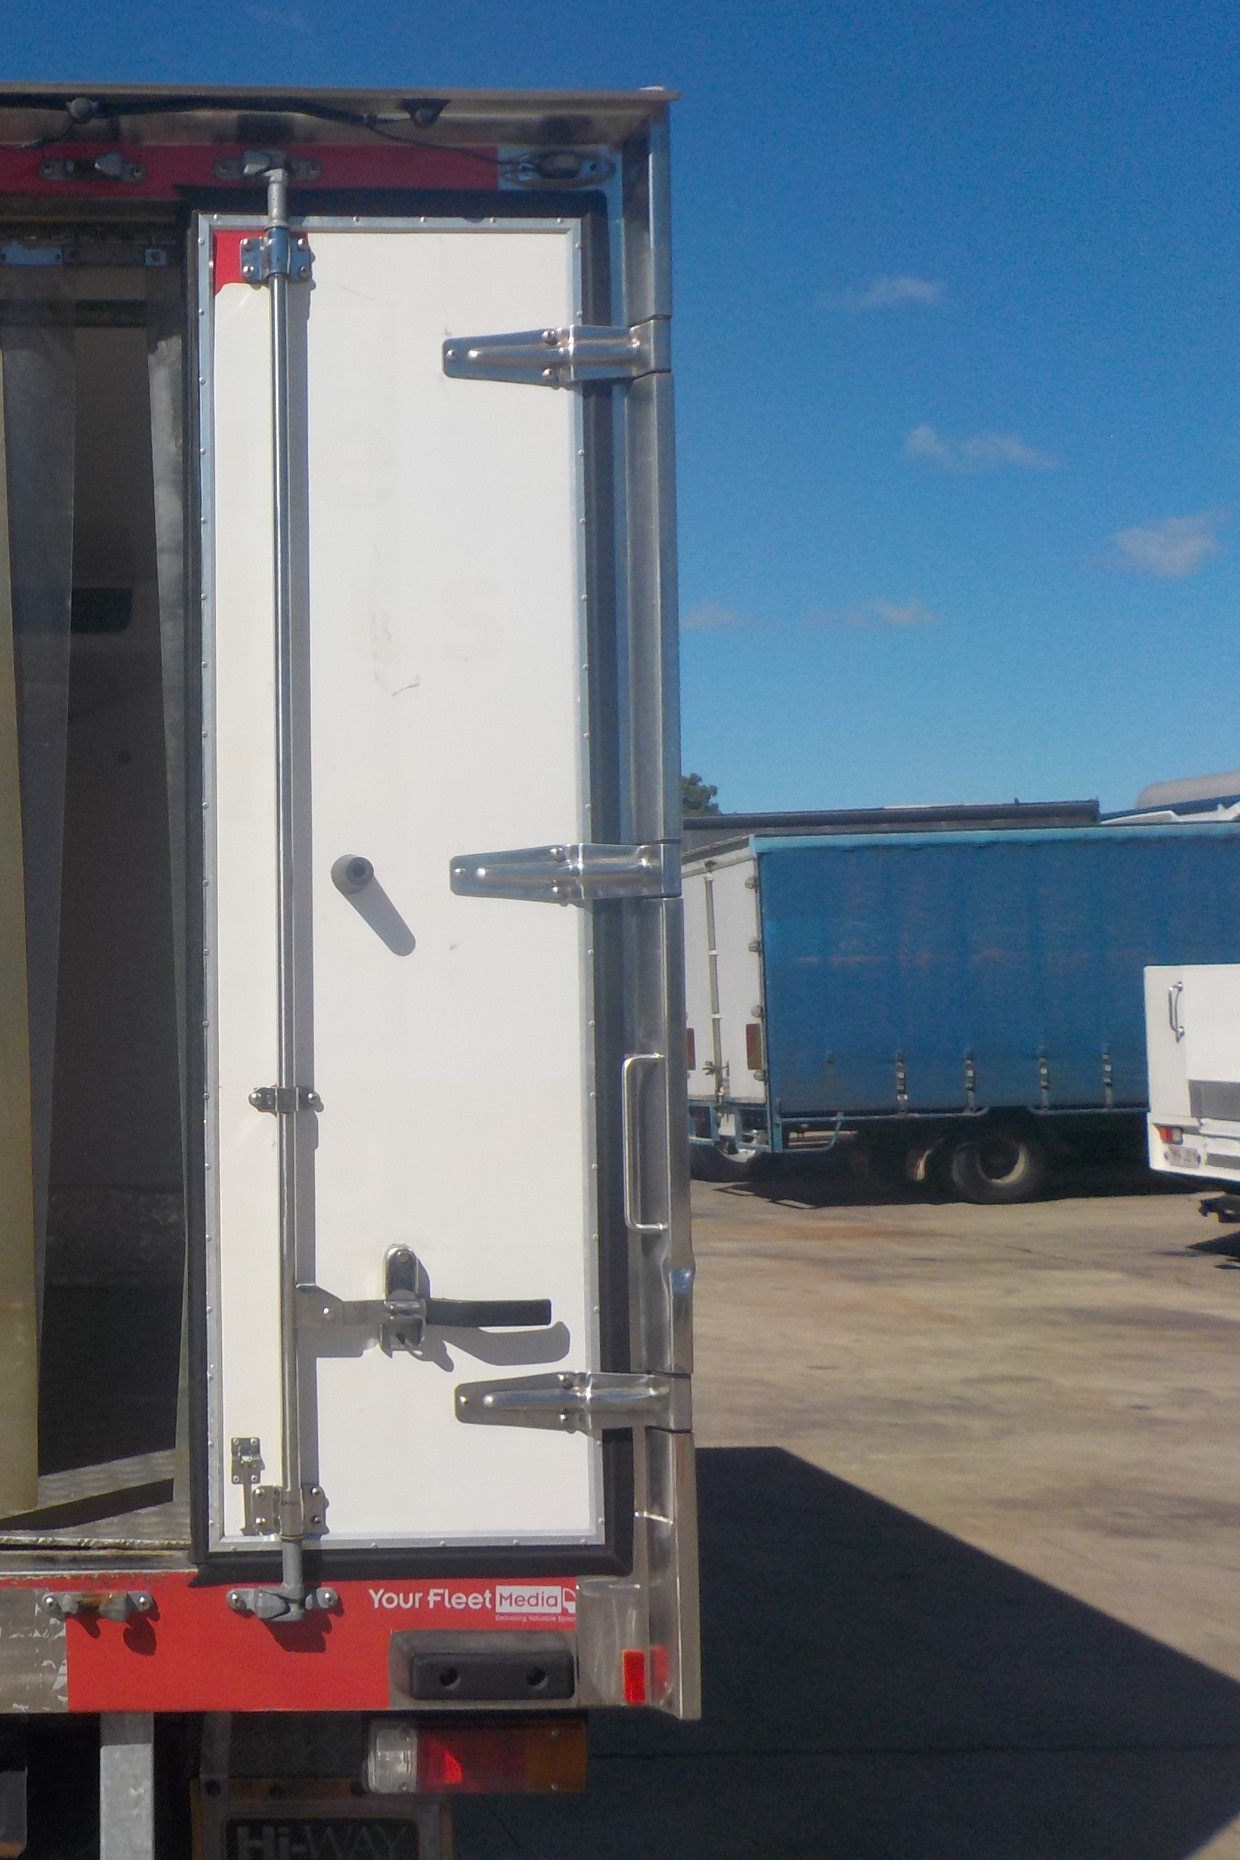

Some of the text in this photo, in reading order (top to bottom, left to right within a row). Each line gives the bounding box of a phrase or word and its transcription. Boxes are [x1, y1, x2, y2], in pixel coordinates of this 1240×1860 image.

[368, 1588, 558, 1609] Your Fleet Media
